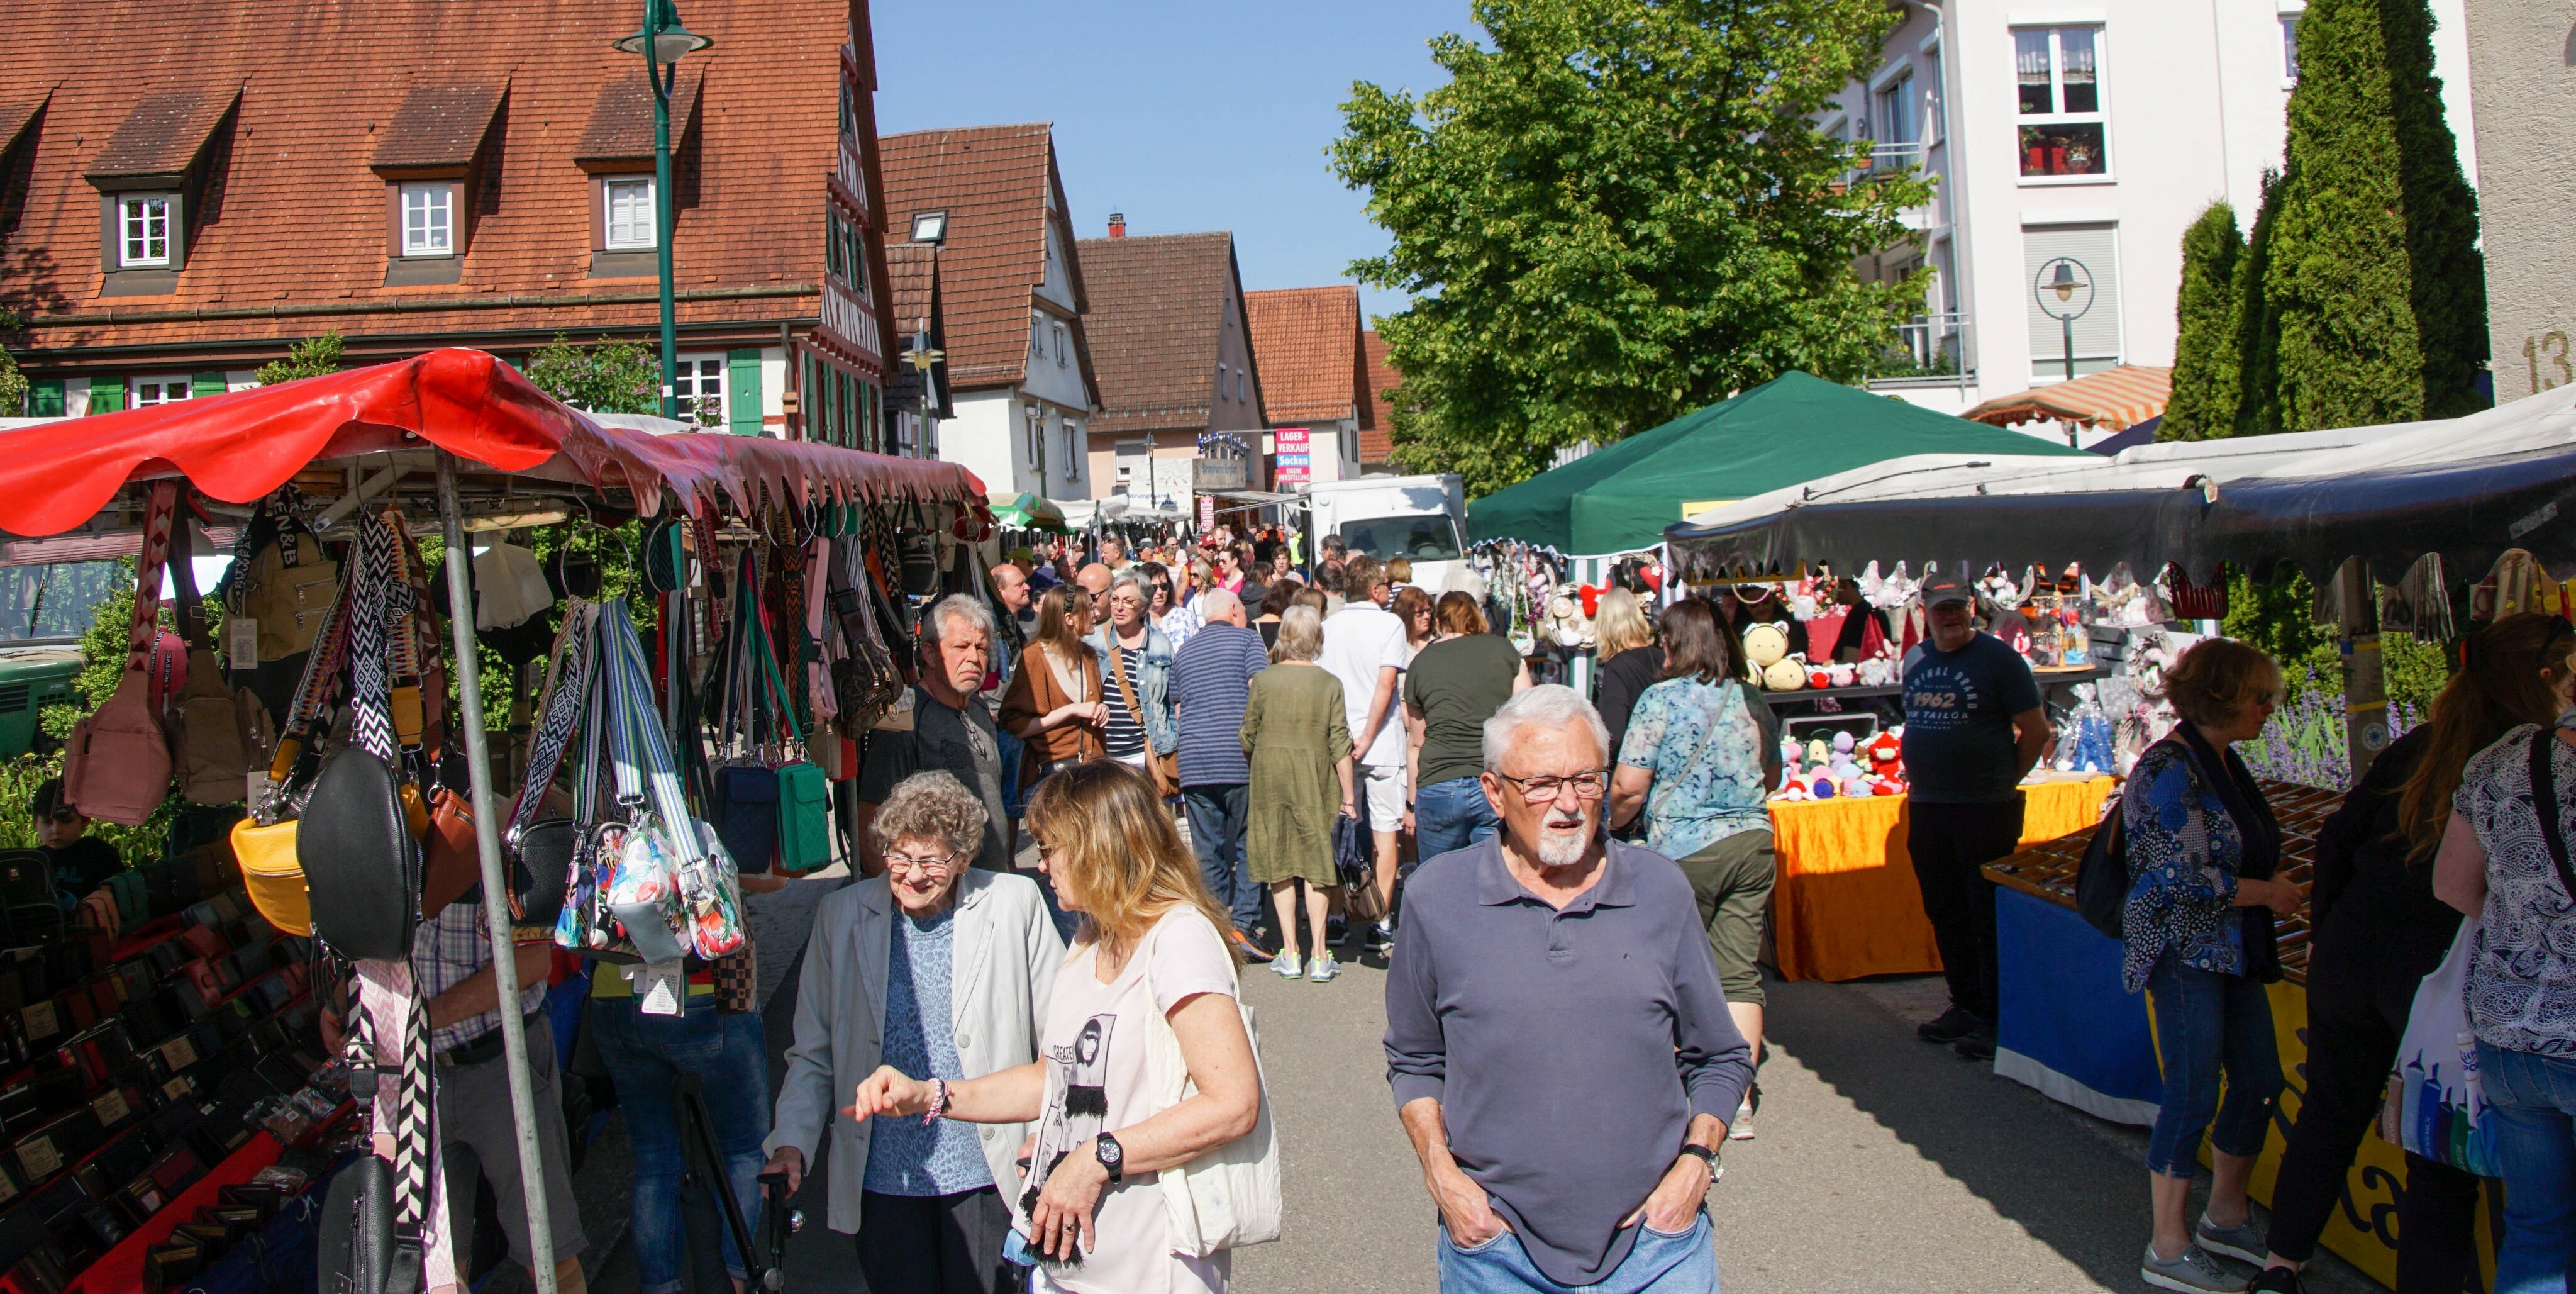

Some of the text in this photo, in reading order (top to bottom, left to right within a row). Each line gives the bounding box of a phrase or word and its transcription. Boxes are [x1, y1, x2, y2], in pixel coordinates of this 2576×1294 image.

[2521, 331, 2573, 395] 13
[1280, 432, 1306, 442] LAGER-
[1277, 443, 1309, 453] VERKAUF
[1279, 455, 1308, 466] Socken
[1954, 671, 1979, 710] BRAND
[1913, 692, 1957, 709] 1962
[1923, 711, 1968, 719] TAILOR
[1053, 1044, 1073, 1061] CREATE
